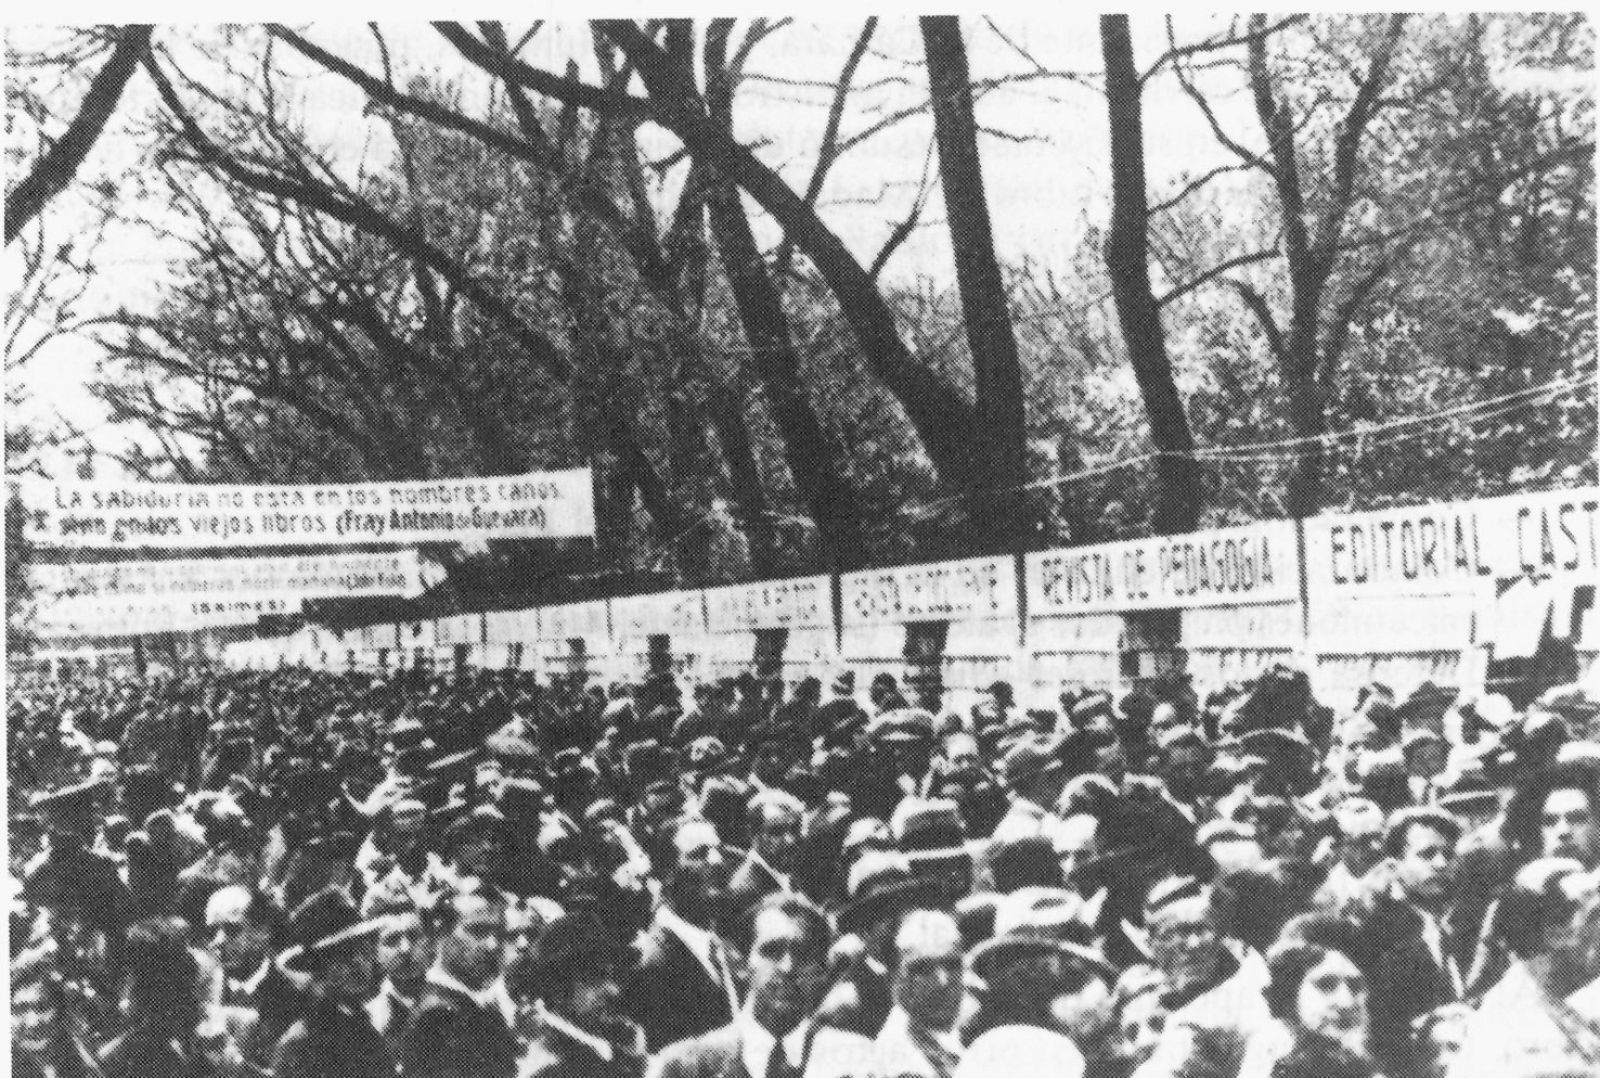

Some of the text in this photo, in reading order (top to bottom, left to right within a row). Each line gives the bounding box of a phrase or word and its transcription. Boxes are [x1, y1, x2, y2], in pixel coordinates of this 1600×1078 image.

[188, 514, 254, 540] viejos
[261, 511, 326, 534] libros
[335, 507, 386, 536] (Fray
[1330, 513, 1492, 584] EDITORIAL
[1042, 553, 1112, 605] REVISTA
[1122, 549, 1149, 600] DE
[1158, 536, 1273, 596] PEDAGOGIA
